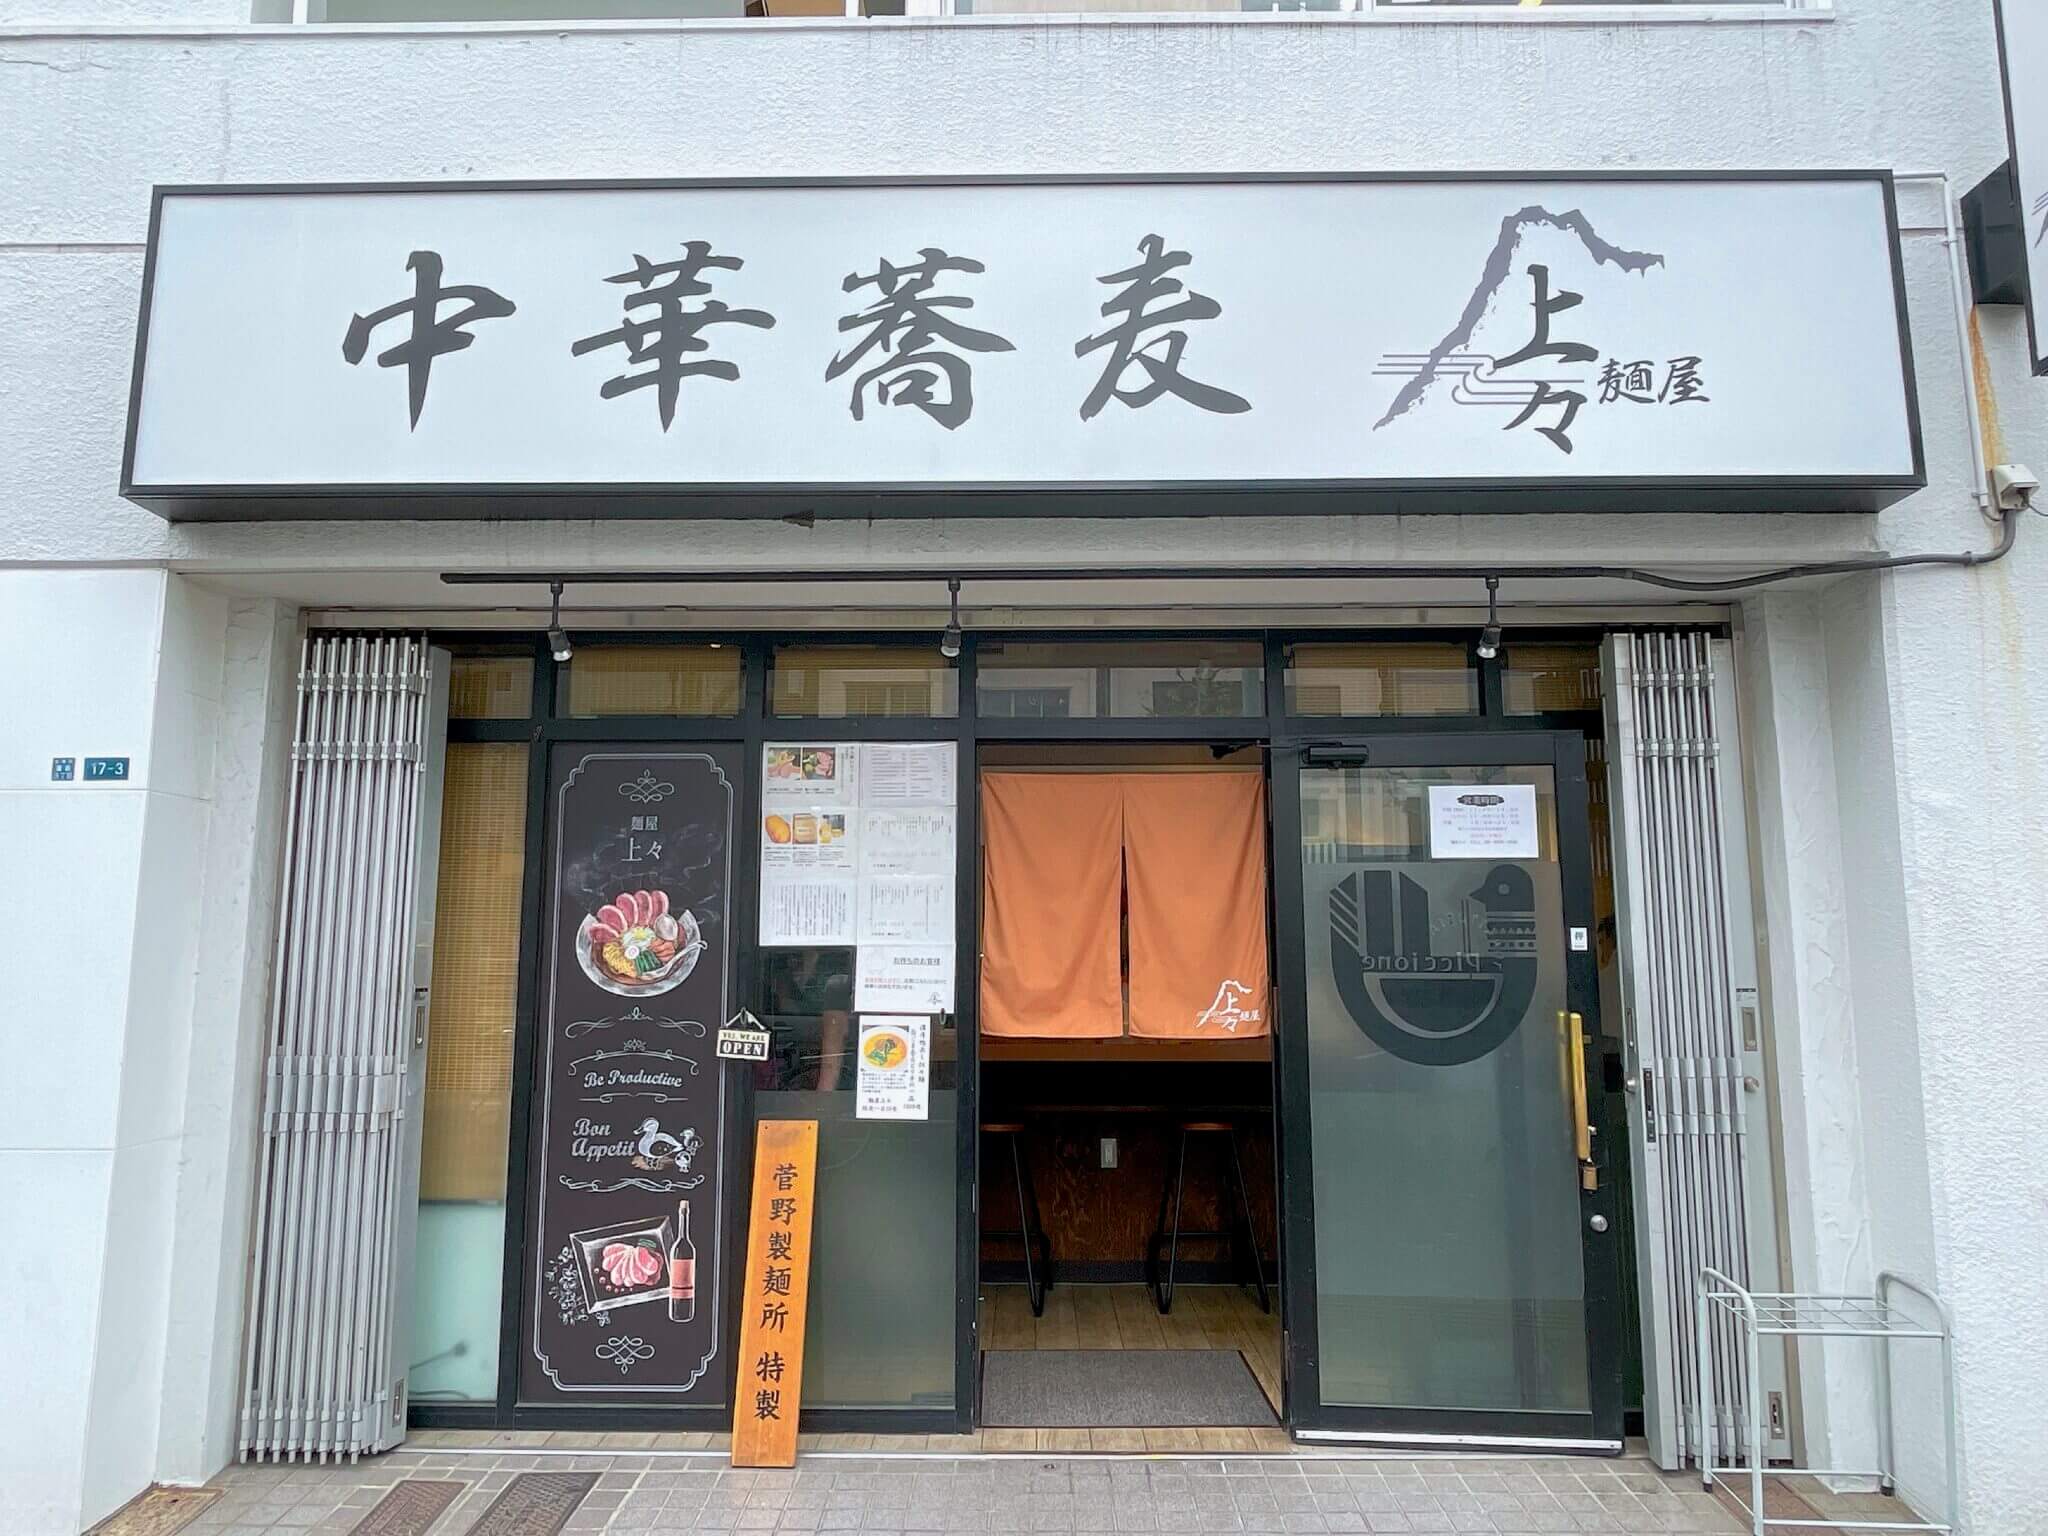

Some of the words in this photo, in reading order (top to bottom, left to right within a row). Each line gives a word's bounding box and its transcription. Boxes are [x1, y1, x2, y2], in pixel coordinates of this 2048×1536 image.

[343, 234, 1252, 433] 中華蕎麦
[1493, 263, 1600, 455] 上々
[1597, 356, 1711, 405] 麺屋
[91, 762, 124, 776] 17-3
[621, 837, 664, 863] 上々
[723, 1042, 762, 1055] OPEN
[584, 1071, 606, 1088] Be
[608, 1069, 683, 1088] Productive
[572, 1118, 611, 1137] Bon
[571, 1138, 636, 1163] Appetit
[759, 1163, 799, 1334] 菅野製麺所
[753, 1351, 786, 1421] 特製
